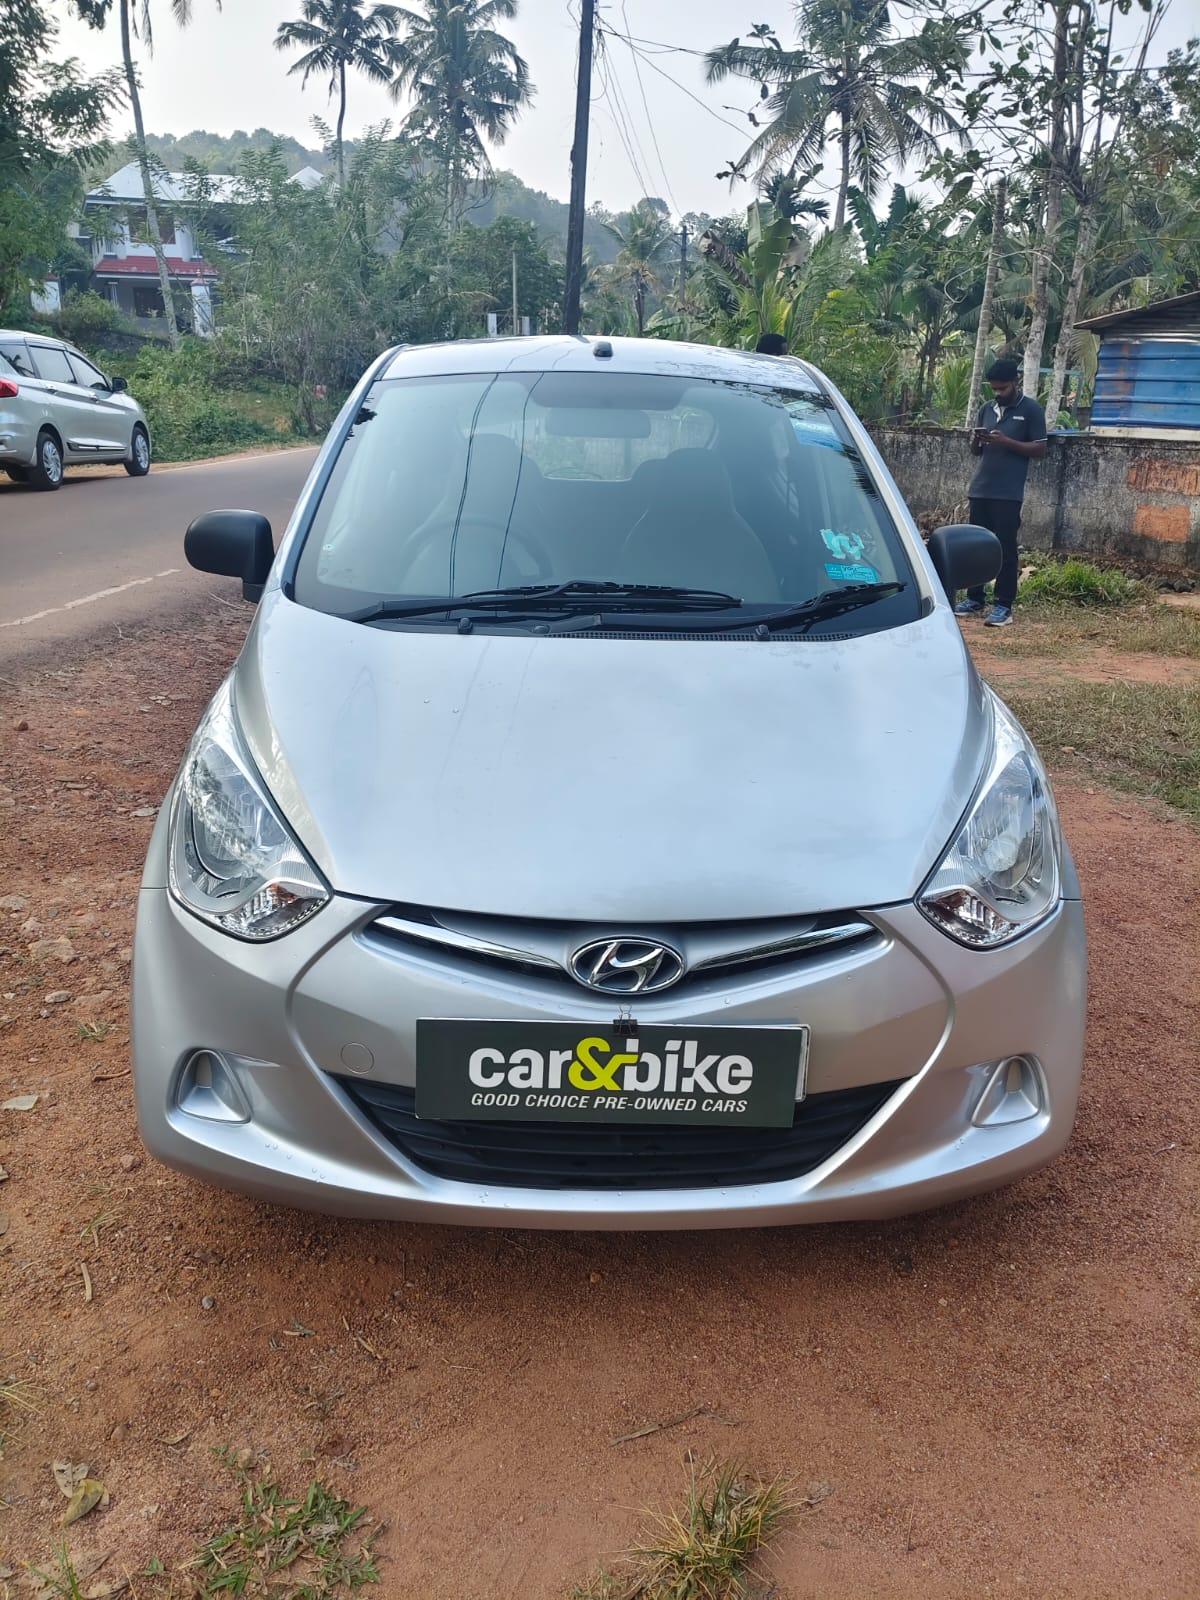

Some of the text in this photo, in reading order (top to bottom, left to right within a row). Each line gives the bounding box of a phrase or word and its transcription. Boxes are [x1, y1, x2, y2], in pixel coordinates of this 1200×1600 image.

[468, 1037, 754, 1095] car&bike
[470, 1093, 748, 1113] GOOD CHOICE PRE-OWNED CARS
